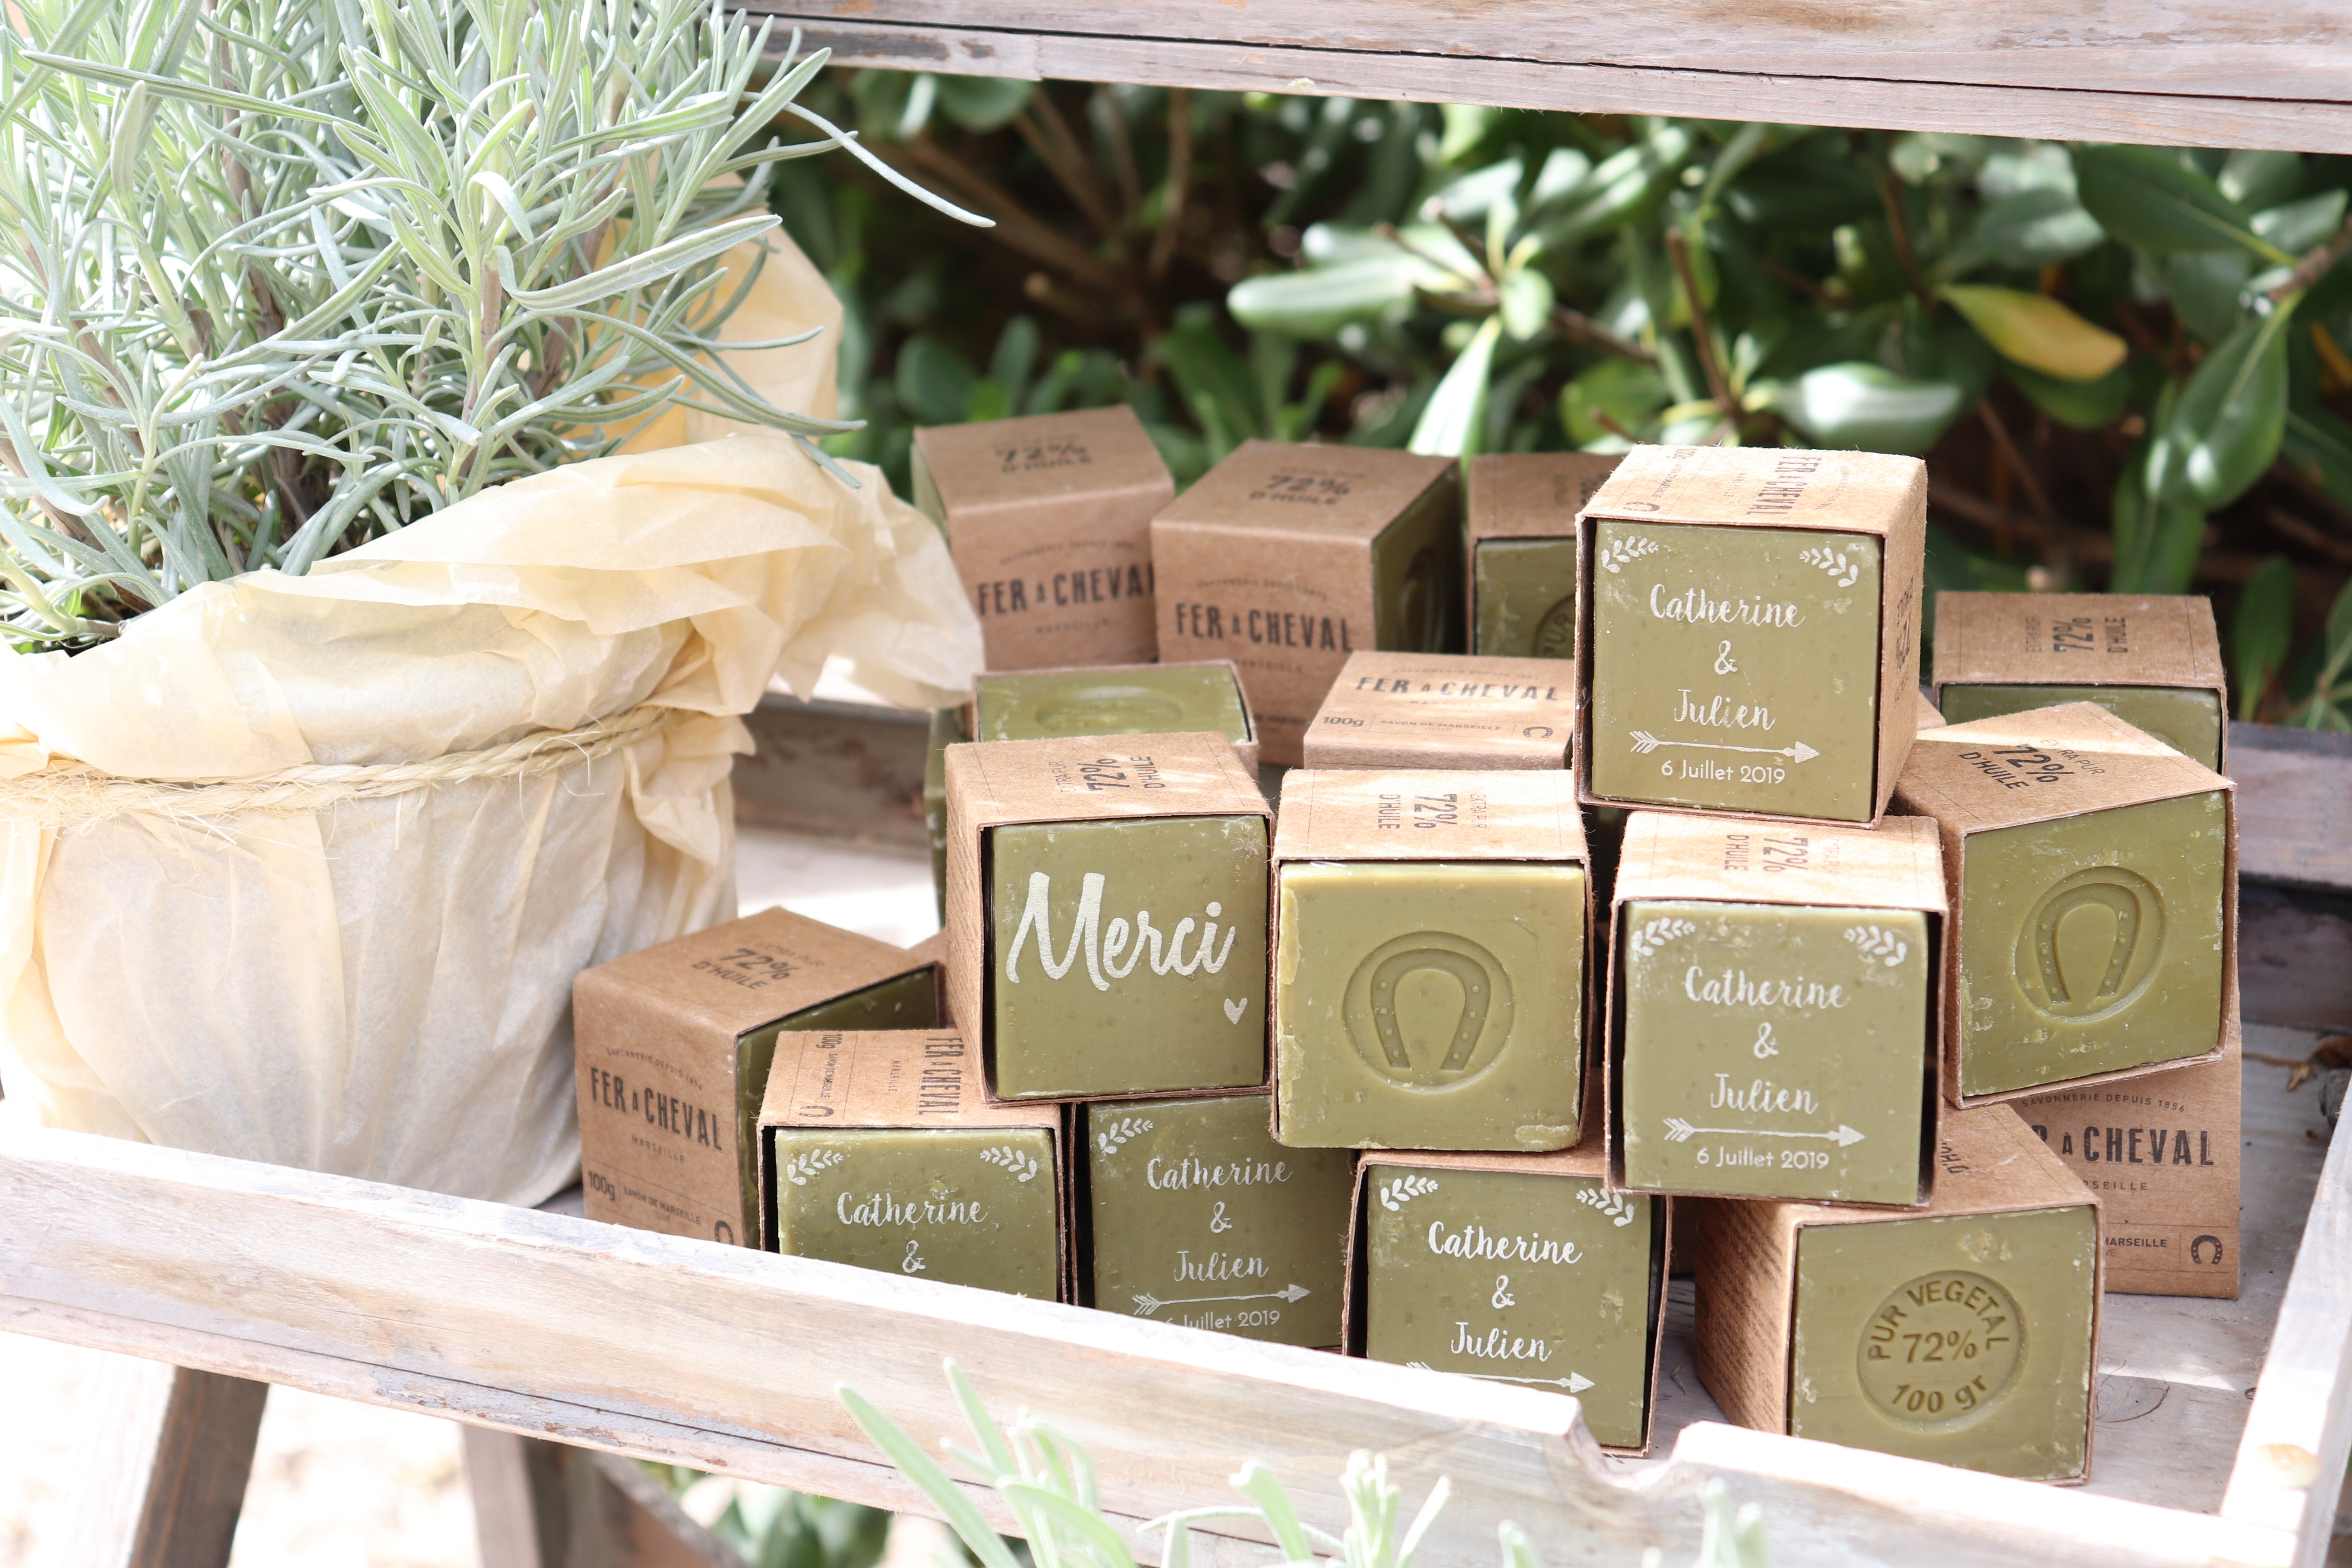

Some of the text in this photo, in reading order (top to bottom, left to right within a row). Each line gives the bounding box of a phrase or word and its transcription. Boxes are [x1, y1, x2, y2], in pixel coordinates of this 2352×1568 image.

[1774, 457, 1822, 472] FER
[1266, 474, 1350, 495] 72%
[1746, 481, 1808, 515] CHEVAL
[978, 579, 1028, 616] FER
[1650, 583, 1806, 628] Catherine
[1175, 602, 1224, 640] FER
[1249, 609, 1354, 653] CHEVAL
[2053, 617, 2094, 653] 72%
[1714, 639, 1738, 675] &
[1356, 677, 1410, 693] FER
[1440, 682, 1559, 701] CHEVAL
[1322, 716, 1365, 728] 100g
[1674, 688, 1776, 731] Julien
[1130, 755, 1167, 789] D'HUILE
[1661, 760, 1786, 784] 6 Juillet 2019
[1959, 752, 2030, 788] D'HUILE
[1993, 744, 2075, 783] 72%
[2039, 738, 2105, 776] EXTRA PUR
[1049, 761, 1077, 793] EXTRA PUR
[1077, 757, 1131, 792] 72%
[1378, 794, 1401, 830] D'HUILE
[1414, 793, 1457, 829] 72%
[1470, 793, 1487, 829] EXTRA PUR
[1724, 834, 1750, 872] D'HUILE
[1762, 837, 1809, 873] 72%
[1006, 871, 1236, 991] Merci
[690, 961, 768, 989] D'HUILE
[719, 948, 801, 980] 72%
[1684, 964, 1851, 1009] Catherine
[816, 1033, 843, 1049] 100g
[924, 1037, 964, 1058] FER
[1753, 1021, 1779, 1059] &
[607, 1049, 653, 1063] SAVONNERIE
[655, 1059, 683, 1078] DEPUIS
[826, 1053, 838, 1067] SAVON
[888, 1060, 901, 1092] MARSEILLE
[820, 1074, 835, 1098] MARSEILLE
[917, 1068, 963, 1116] CHEVAL
[1710, 1072, 1819, 1115] Julien
[2022, 1094, 2185, 1112] SAVONNERIE DEPUIS 1856
[591, 1067, 626, 1113] FER
[644, 1087, 722, 1151] CHEVAL
[632, 1135, 685, 1164] MARSEILLE
[1696, 1146, 1829, 1169] 6 Juillet 2019
[1940, 1142, 1972, 1174] D'HU
[2084, 1126, 2214, 1165] CHEVAL
[588, 1171, 616, 1202] 100g
[1147, 1158, 1293, 1190] Catherine
[2083, 1180, 2147, 1190] SEILLE
[624, 1187, 700, 1225] SAVON DE MARSEILLE
[837, 1192, 989, 1226] Catherine
[1210, 1201, 1232, 1234] &
[902, 1240, 926, 1273] &
[1428, 1221, 1583, 1265] Catherine
[1174, 1251, 1269, 1282] Julien
[1491, 1274, 1516, 1310] &
[1238, 1310, 1280, 1327] 2019
[1867, 1281, 2009, 1361] PUR VEGETAL
[1451, 1321, 1552, 1362] Julien
[1903, 1330, 1978, 1364] 72%
[1892, 1375, 1987, 1413] 100 gr
